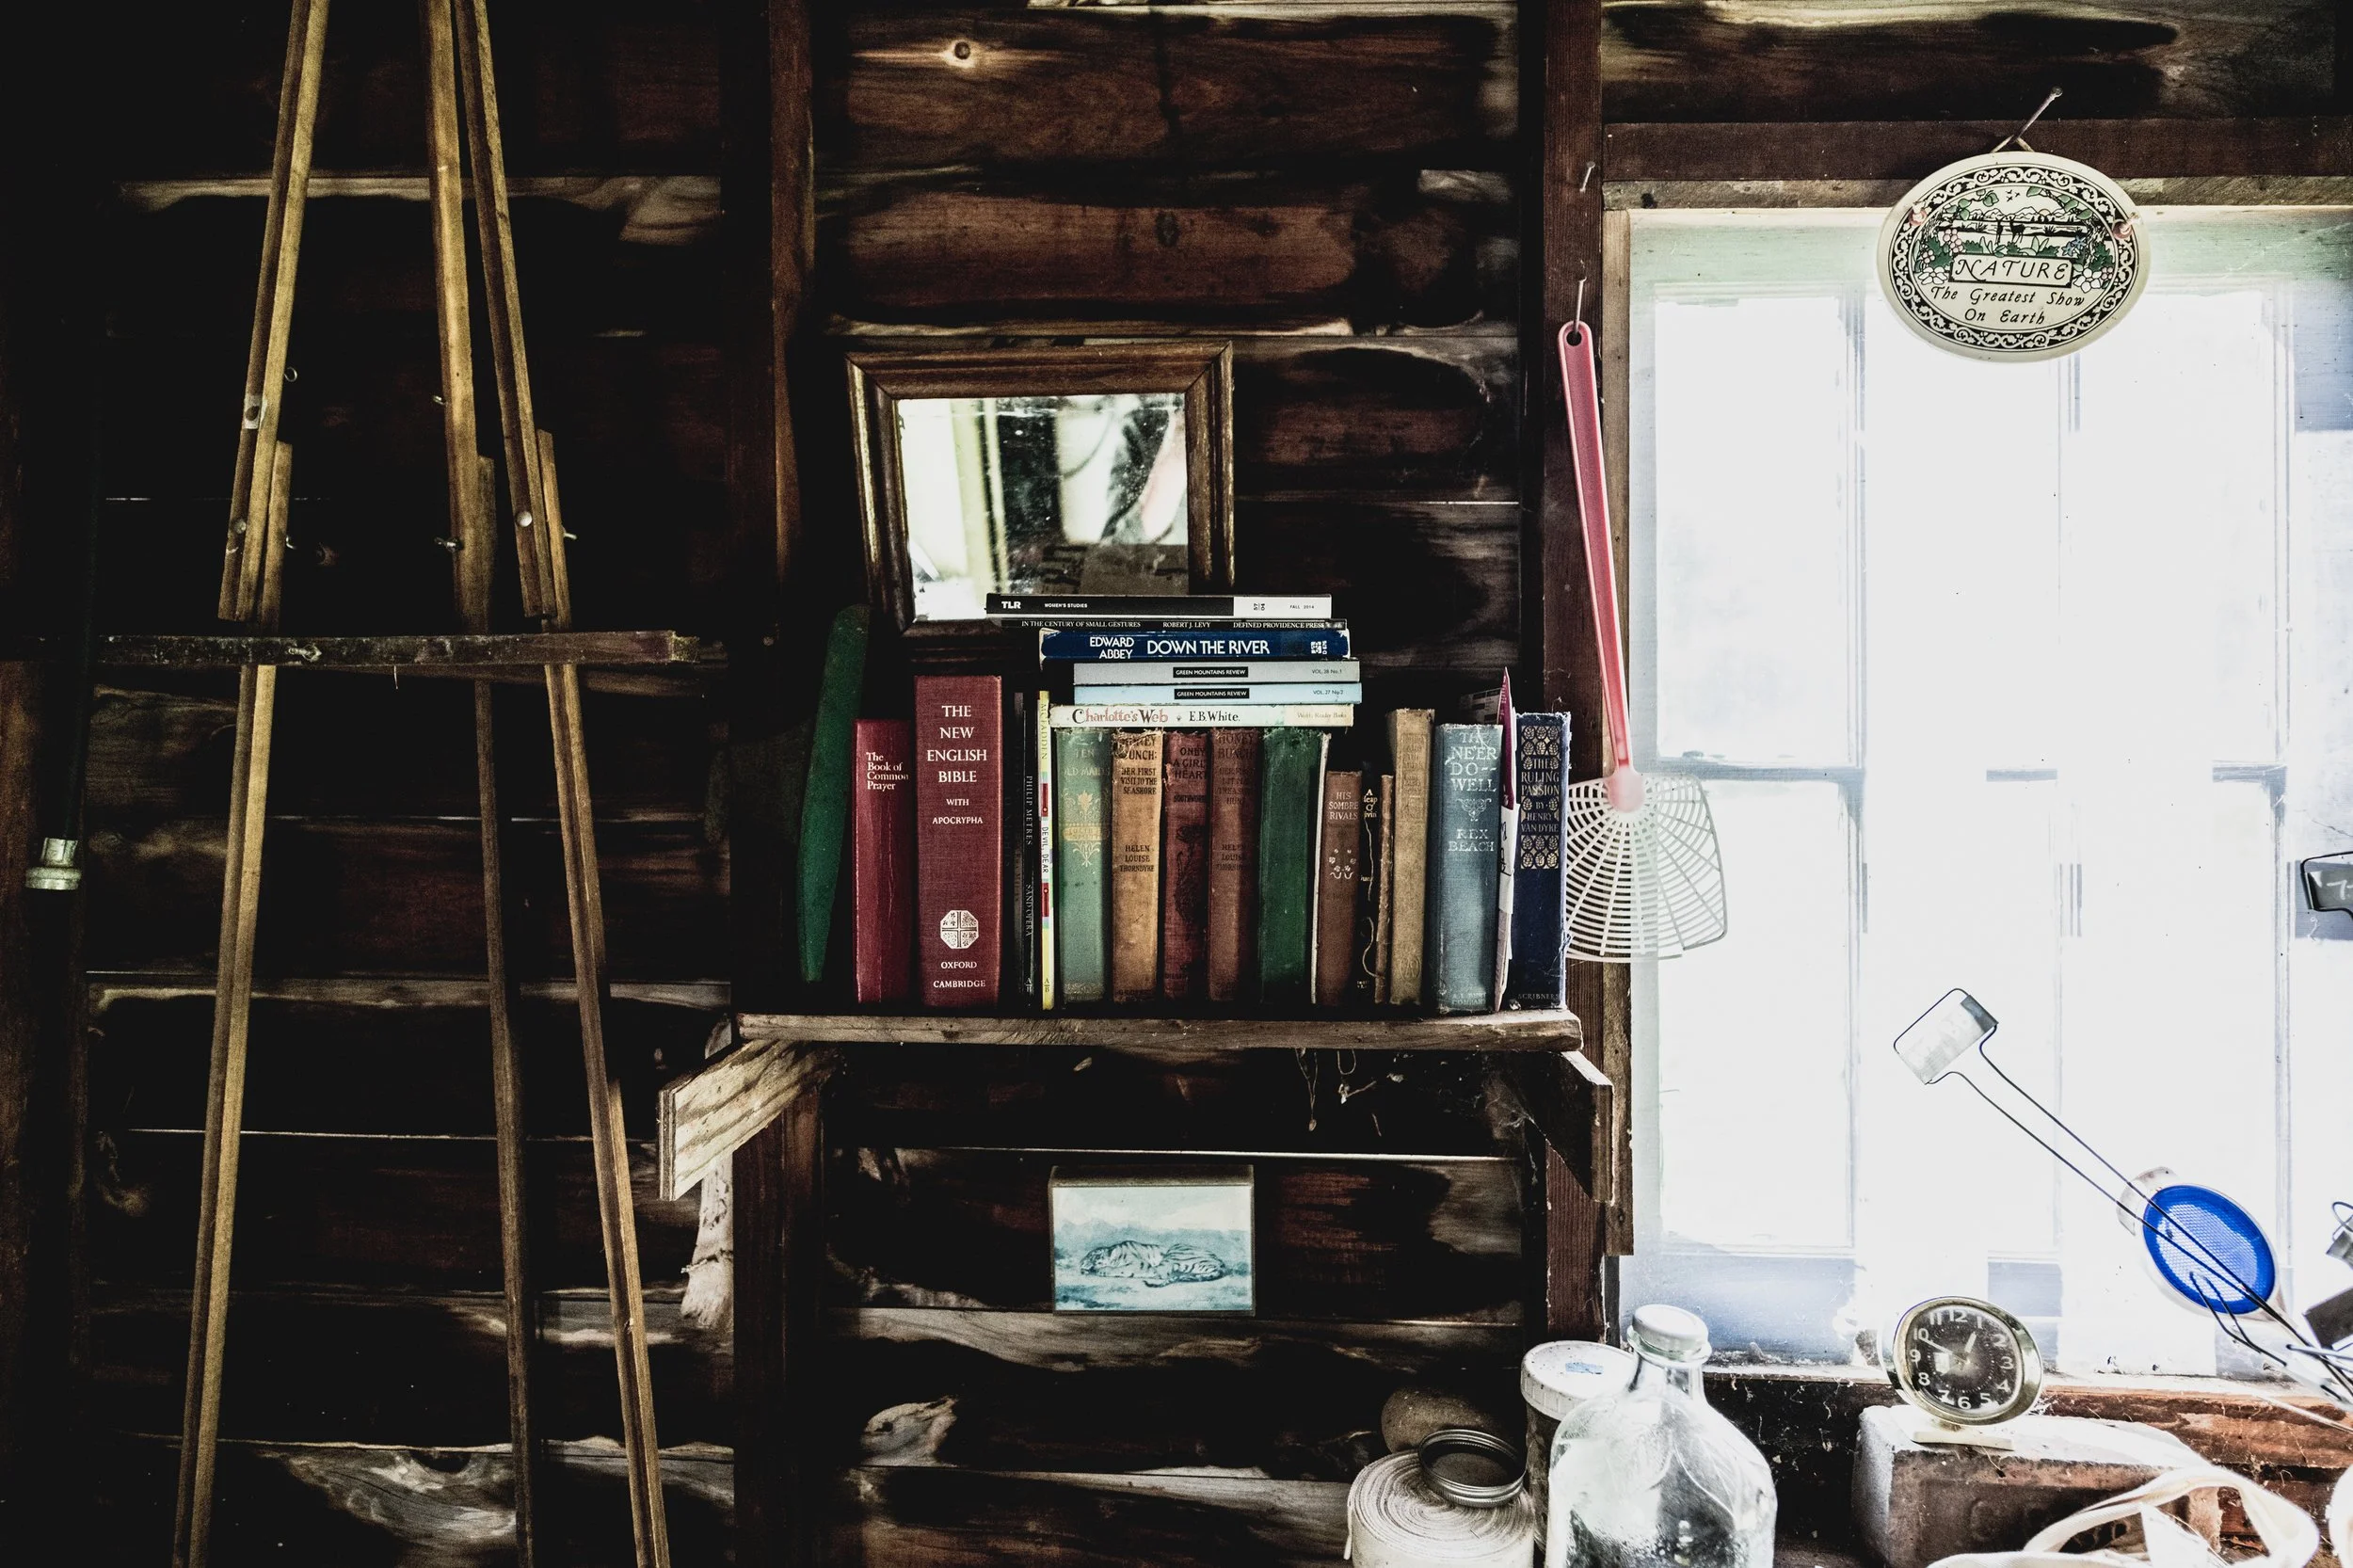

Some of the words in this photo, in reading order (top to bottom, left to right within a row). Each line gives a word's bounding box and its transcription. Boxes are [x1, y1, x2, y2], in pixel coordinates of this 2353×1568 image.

[1955, 259, 2069, 280] NATURE
[1930, 286, 1958, 300] The
[1970, 289, 2036, 305] Greatest
[2047, 292, 2085, 307] Show
[1964, 308, 1986, 322] On
[2000, 310, 2045, 325] Earth
[1090, 636, 1134, 648] EDWARD
[1147, 640, 1196, 655] DOWN
[1200, 640, 1225, 654] THE
[1229, 640, 1270, 654] RIVER
[1099, 649, 1133, 659] ABBEY
[941, 705, 972, 718] THE
[1072, 708, 1138, 724] Charlotte's
[1138, 709, 1169, 724] Web
[939, 727, 974, 739] NEW
[866, 752, 884, 761] The
[926, 749, 987, 762] ENGLISH
[867, 761, 889, 771] Book
[890, 761, 904, 771] of
[1173, 759, 1180, 767] A
[1533, 759, 1550, 770] THE
[867, 771, 909, 781] Common
[937, 770, 978, 783] BIBLE
[1137, 767, 1157, 776] FIRST
[1521, 771, 1560, 784] RULING
[867, 781, 897, 791] Prayer
[1120, 776, 1137, 786] VISIT
[1137, 776, 1145, 786] TO
[1145, 776, 1158, 786] THE
[1450, 777, 1497, 792] WELL
[1123, 786, 1158, 795] SEASHORE
[1336, 792, 1352, 800] HIS
[1521, 784, 1561, 797] PASSION
[1328, 802, 1359, 810] SOMBRE
[1363, 795, 1378, 805] eap
[932, 816, 984, 824] APOCRYPHA
[1329, 811, 1358, 820] RIVALS
[1527, 812, 1553, 822] HENRY
[1456, 828, 1489, 840] REX
[1521, 824, 1537, 833] VAN
[1538, 824, 1559, 833] DYKE
[1125, 844, 1150, 853] HELEN
[1448, 840, 1495, 852] BEACH
[1041, 854, 1049, 873] DEAR
[1124, 855, 1150, 863] LOUISE
[1221, 854, 1244, 862] LOUIS
[940, 961, 978, 969] OXFORD
[933, 979, 986, 988] CAMBRIDGE
[1929, 1312, 1943, 1325] 11
[1949, 1310, 1968, 1323] 12
[1977, 1317, 1983, 1329] 1
[1913, 1328, 1929, 1340] 10
[1993, 1334, 2008, 1347] 2
[1909, 1349, 1921, 1368] 9
[2000, 1356, 2013, 1369] 3
[1918, 1372, 1930, 1386] 8
[1995, 1379, 2011, 1393] 4
[1958, 1396, 1972, 1409] 6
[1979, 1393, 1992, 1403] 5
